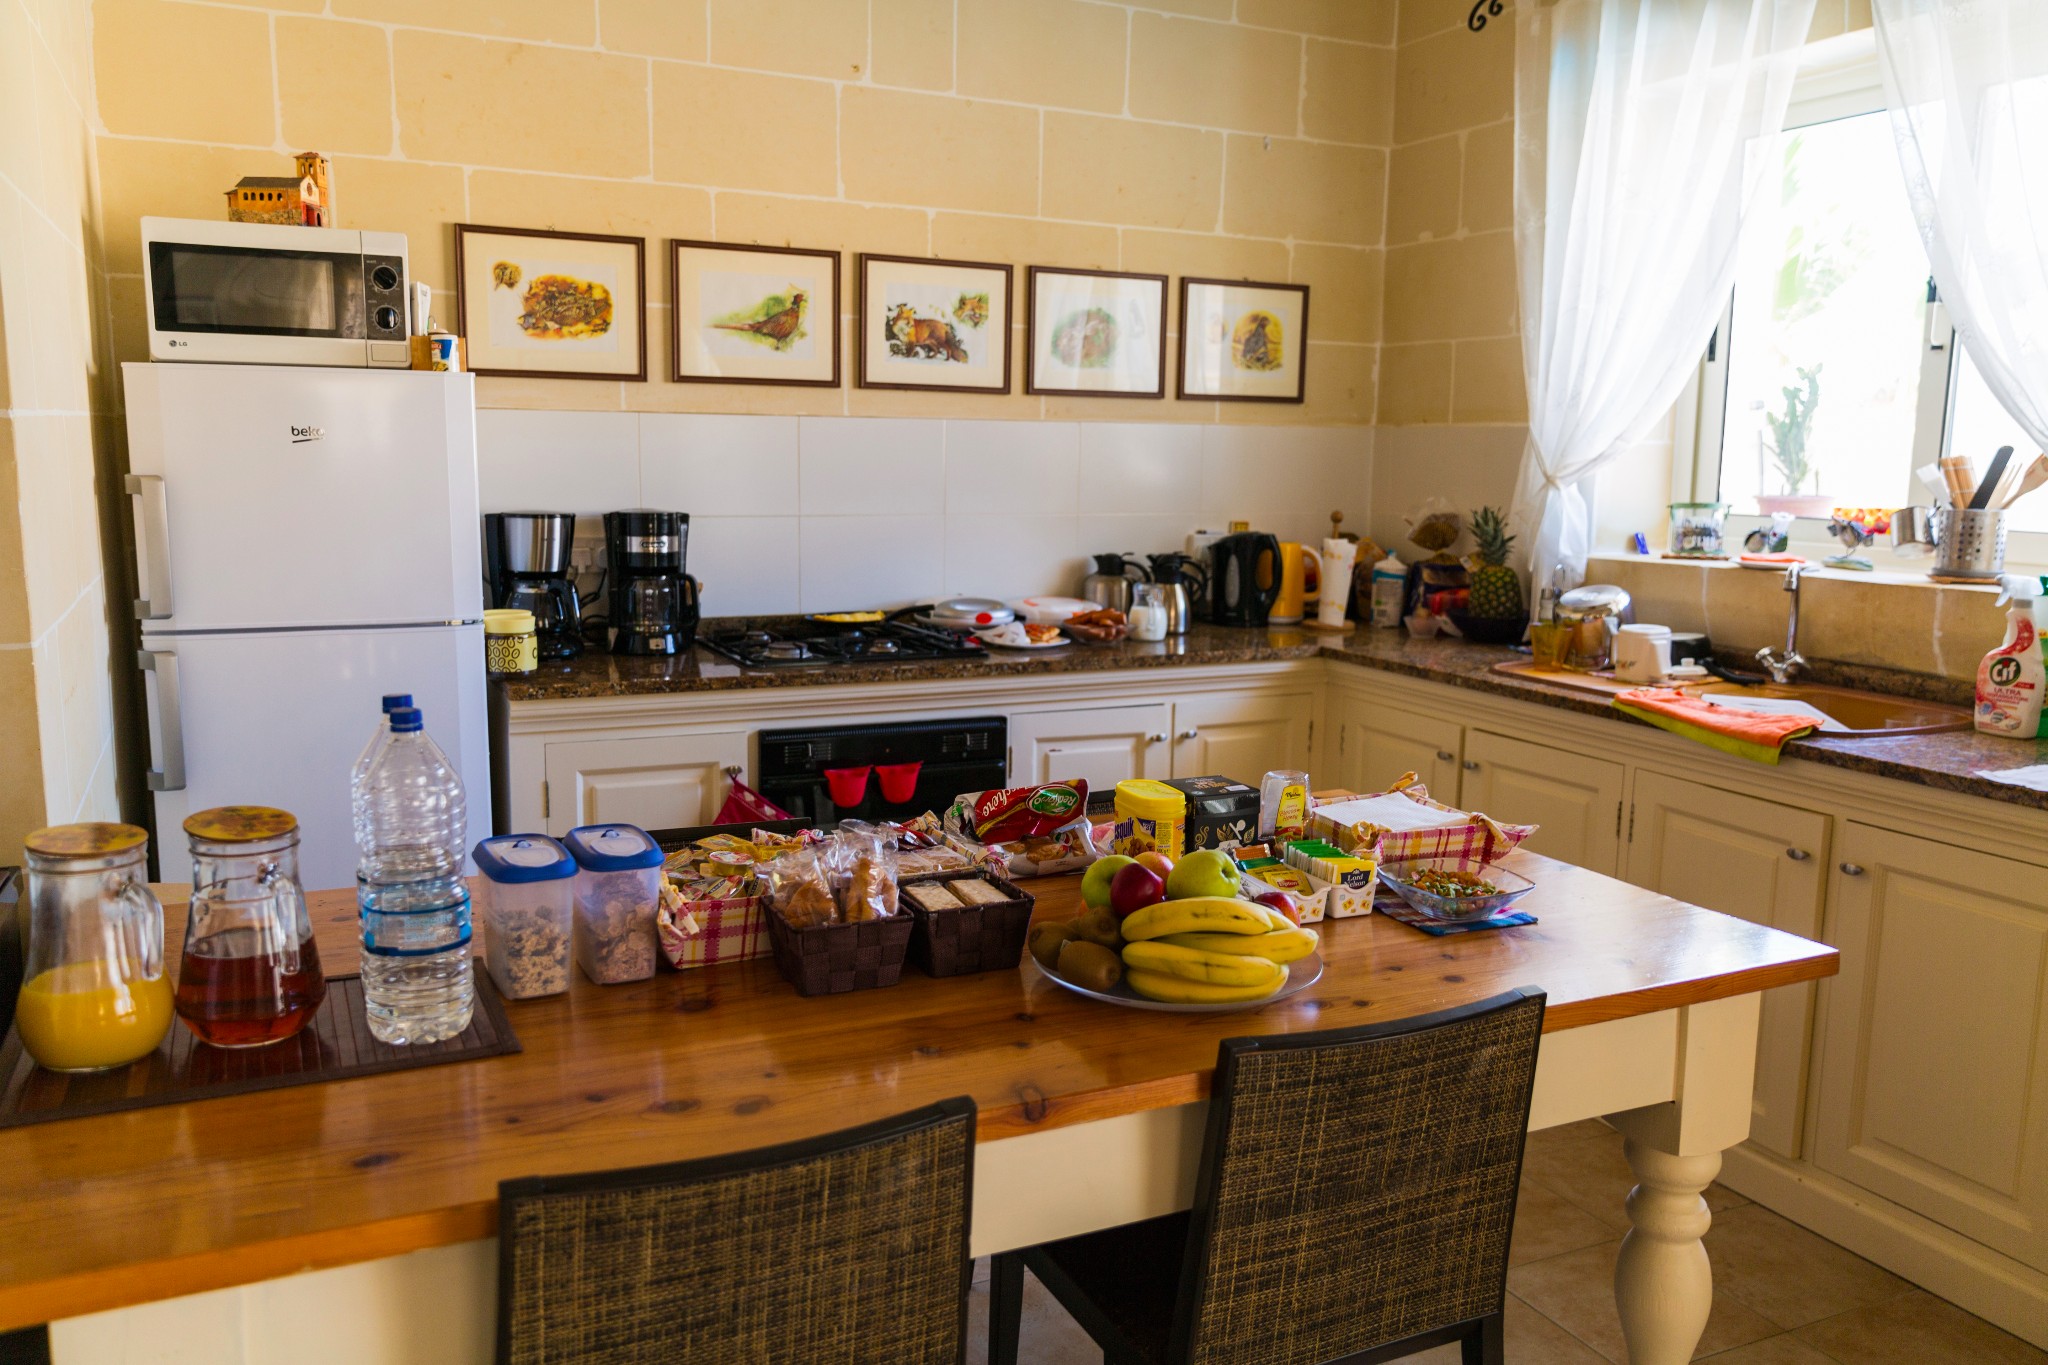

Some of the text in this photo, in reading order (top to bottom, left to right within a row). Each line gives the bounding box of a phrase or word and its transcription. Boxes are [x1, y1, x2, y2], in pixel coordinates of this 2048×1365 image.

[291, 425, 325, 437] beko
[1992, 659, 2017, 682] Cif
[1114, 816, 1135, 843] squik
[1347, 873, 1364, 883] Lord
